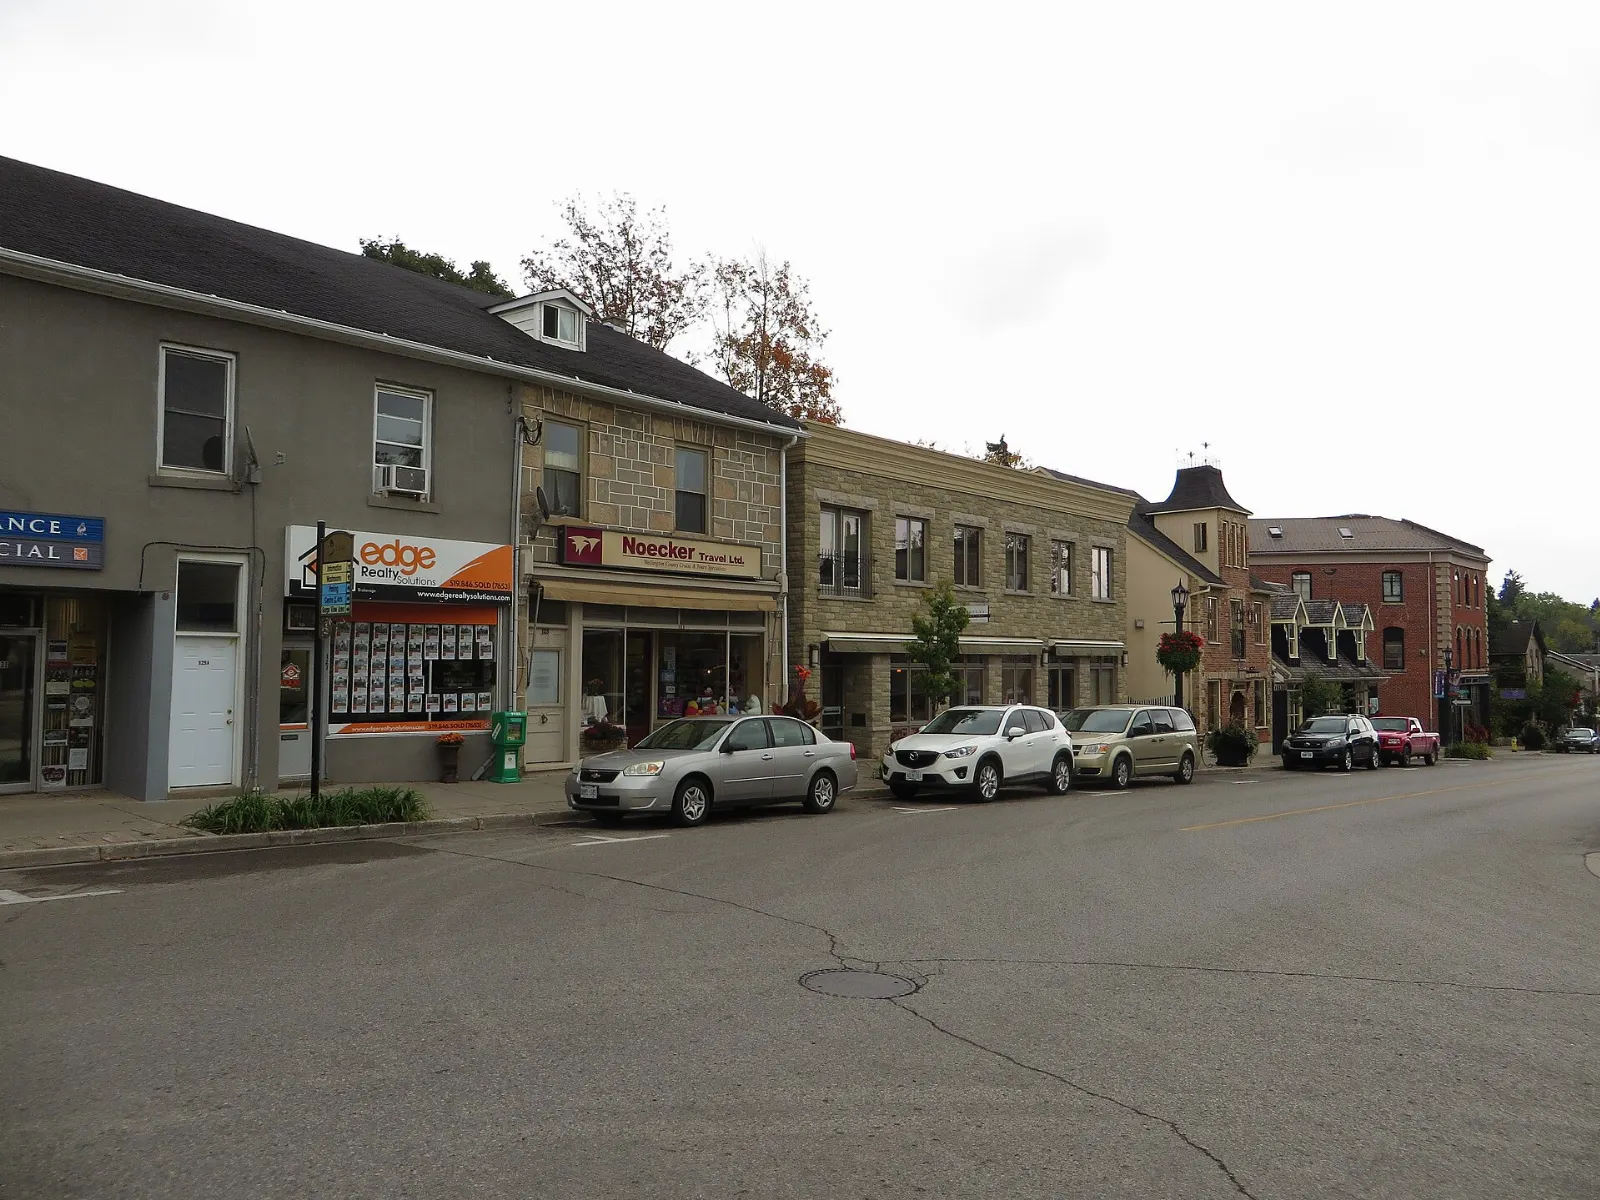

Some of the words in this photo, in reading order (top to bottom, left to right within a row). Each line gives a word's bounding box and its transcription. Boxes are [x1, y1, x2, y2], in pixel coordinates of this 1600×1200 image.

[0, 517, 61, 534] NCE
[360, 539, 436, 576] edge
[622, 536, 695, 560] Noecker
[699, 553, 727, 563] Travel
[729, 556, 745, 564] Ltd.
[361, 566, 400, 581] Realty
[396, 576, 436, 586] Solutions
[449, 580, 491, 588] 519.846.SOLD
[417, 590, 511, 601] www.edgerealtysolutions.com
